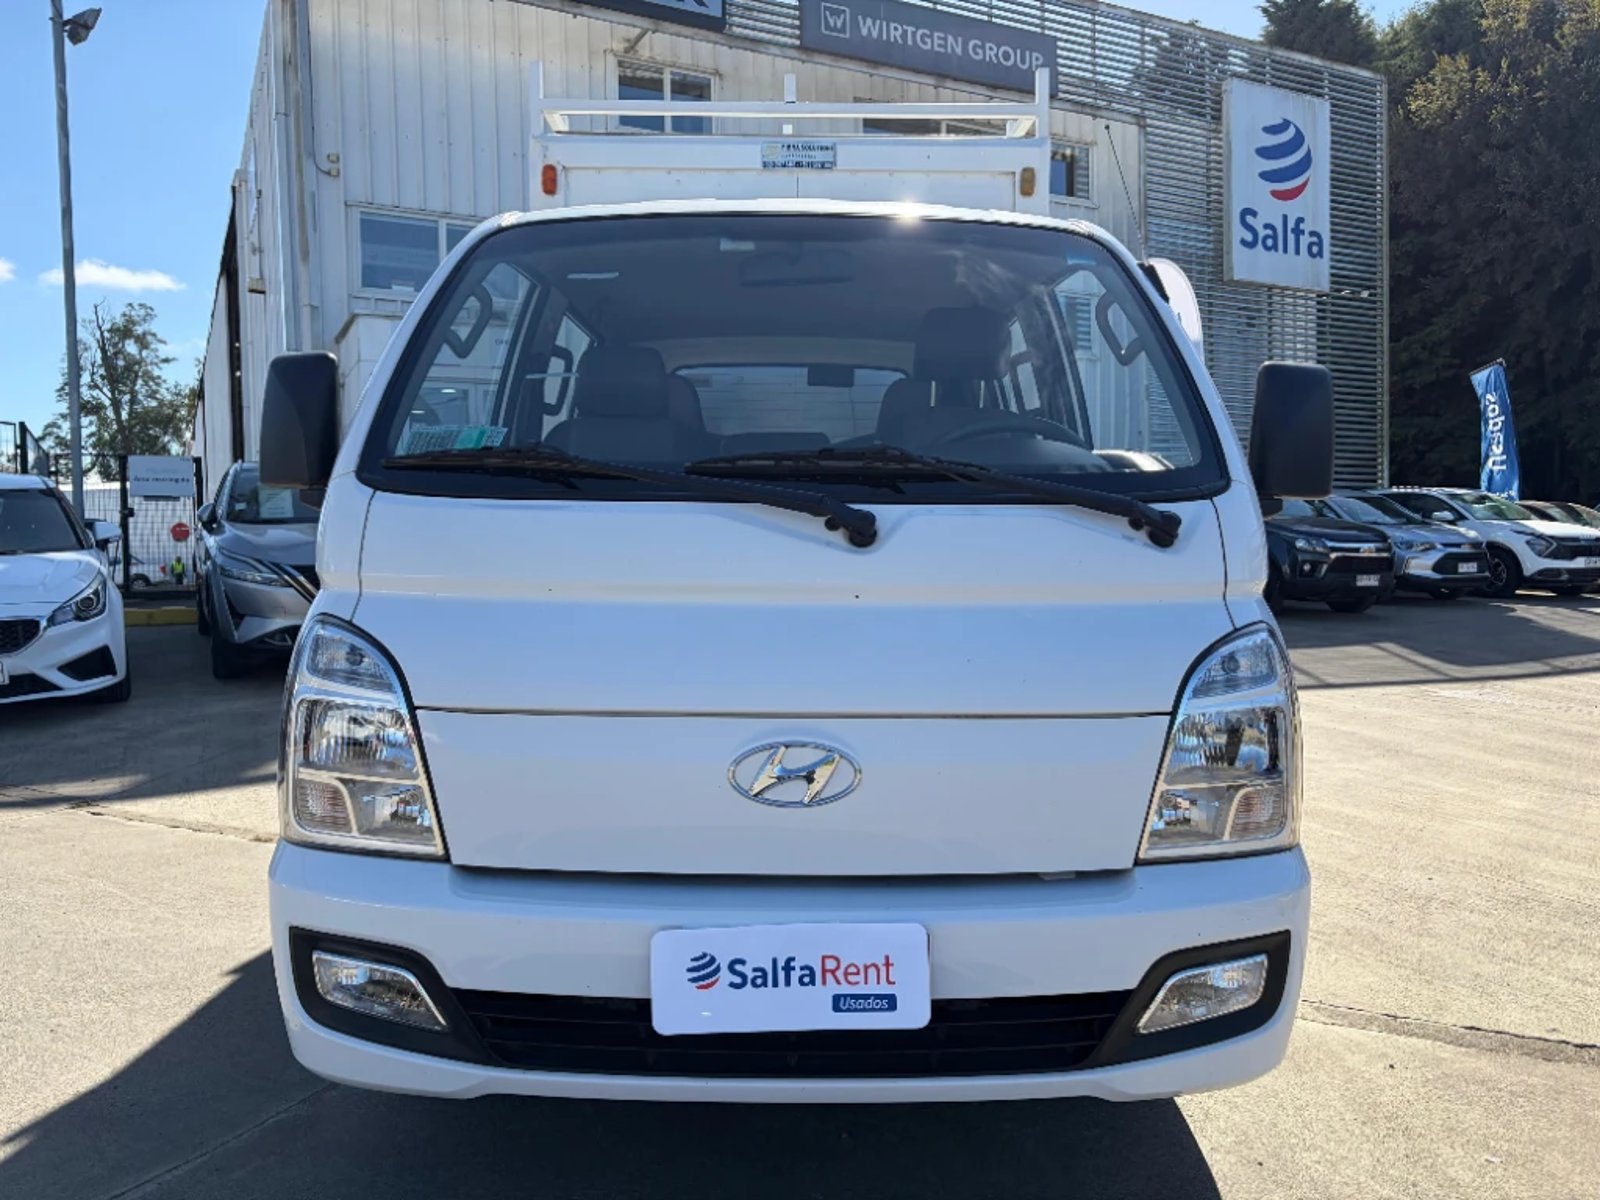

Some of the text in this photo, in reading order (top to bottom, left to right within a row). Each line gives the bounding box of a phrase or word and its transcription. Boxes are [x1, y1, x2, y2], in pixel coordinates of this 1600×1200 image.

[857, 15, 963, 57] WIRTGEN
[968, 39, 1044, 71] GROUP
[1239, 207, 1324, 259] Salfa
[727, 954, 896, 990] SalfaRent
[839, 996, 889, 1010] Usados
